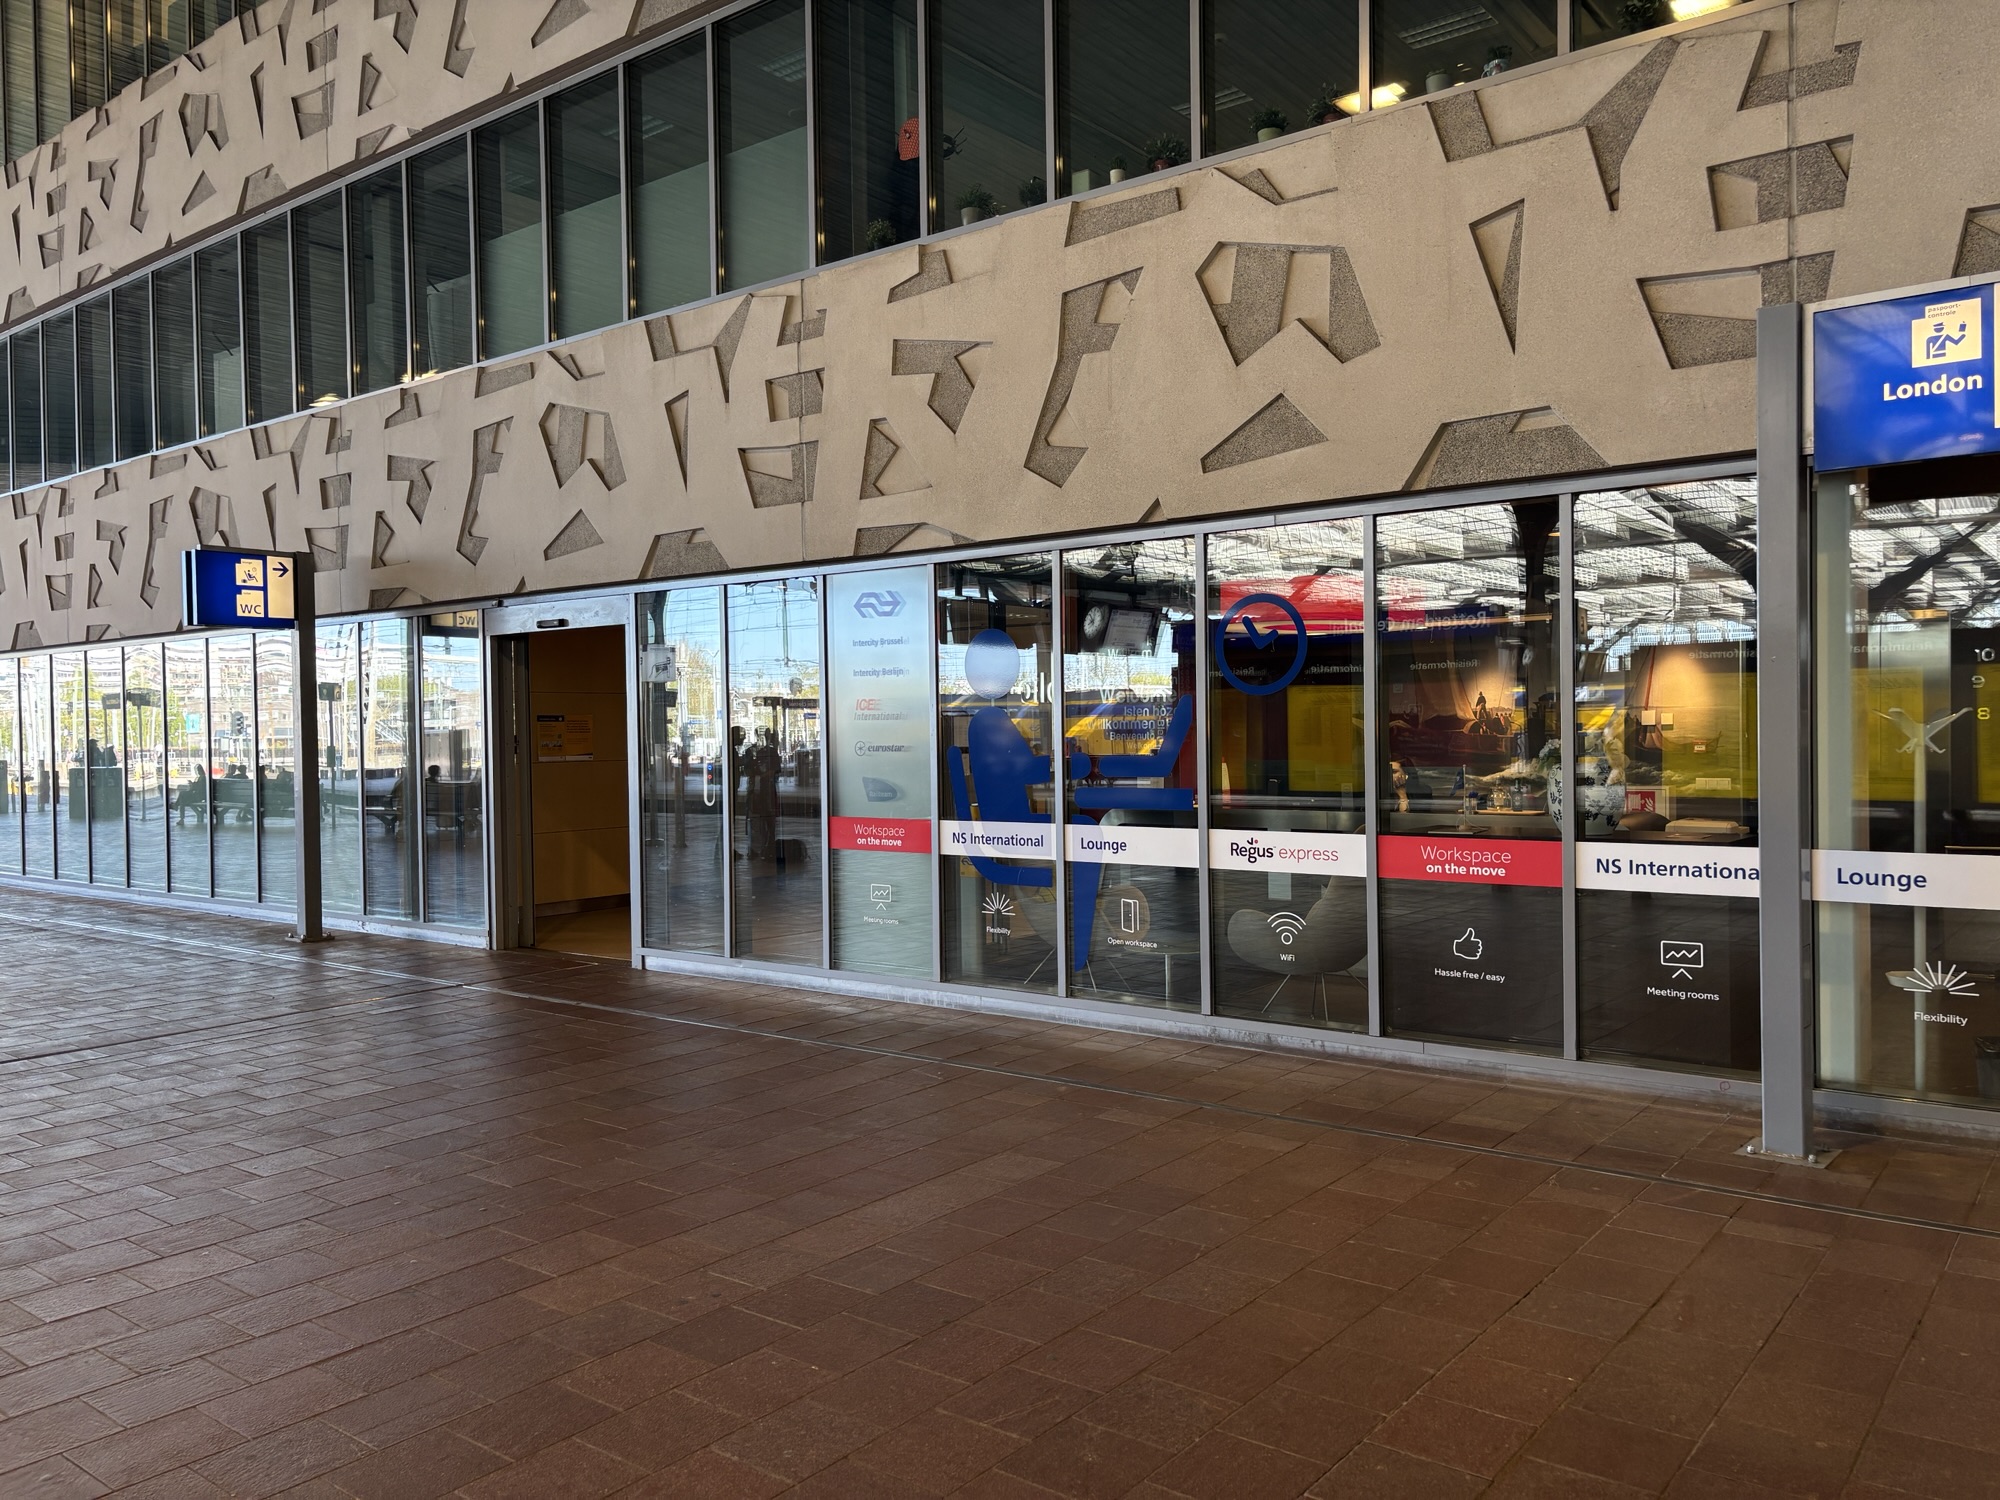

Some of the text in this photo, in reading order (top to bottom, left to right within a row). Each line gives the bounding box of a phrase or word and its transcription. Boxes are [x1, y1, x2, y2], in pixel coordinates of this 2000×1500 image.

[1927, 303, 1961, 313] paspoort-
[1927, 310, 1957, 319] controle
[1883, 373, 1983, 401] London
[240, 603, 262, 615] WC
[852, 638, 879, 648] Intercity
[852, 667, 881, 678] Intercity
[855, 698, 876, 711] ICE
[853, 711, 903, 721] International
[867, 744, 905, 753] eurostar
[854, 823, 906, 838] Workspace
[867, 837, 881, 846] the
[881, 839, 902, 847] move
[952, 831, 1044, 848] NS International
[1080, 837, 1127, 854] Lounge
[1230, 840, 1340, 864] Regus express
[1420, 844, 1512, 866] Workspace
[1426, 863, 1506, 877] on the move
[1596, 858, 1760, 881] NS Internationa
[1837, 867, 1928, 892] Lounge
[863, 915, 883, 925] Meeting
[986, 926, 1011, 936] Flexibility
[1107, 937, 1158, 949] Open workspace
[1279, 953, 1296, 962] WiFi
[1434, 967, 1462, 978] Hassle
[1462, 970, 1480, 980] free
[1485, 974, 1506, 984] easy
[1646, 986, 1720, 1001] Meeting rooms
[1914, 1011, 1968, 1027] Flexibility
